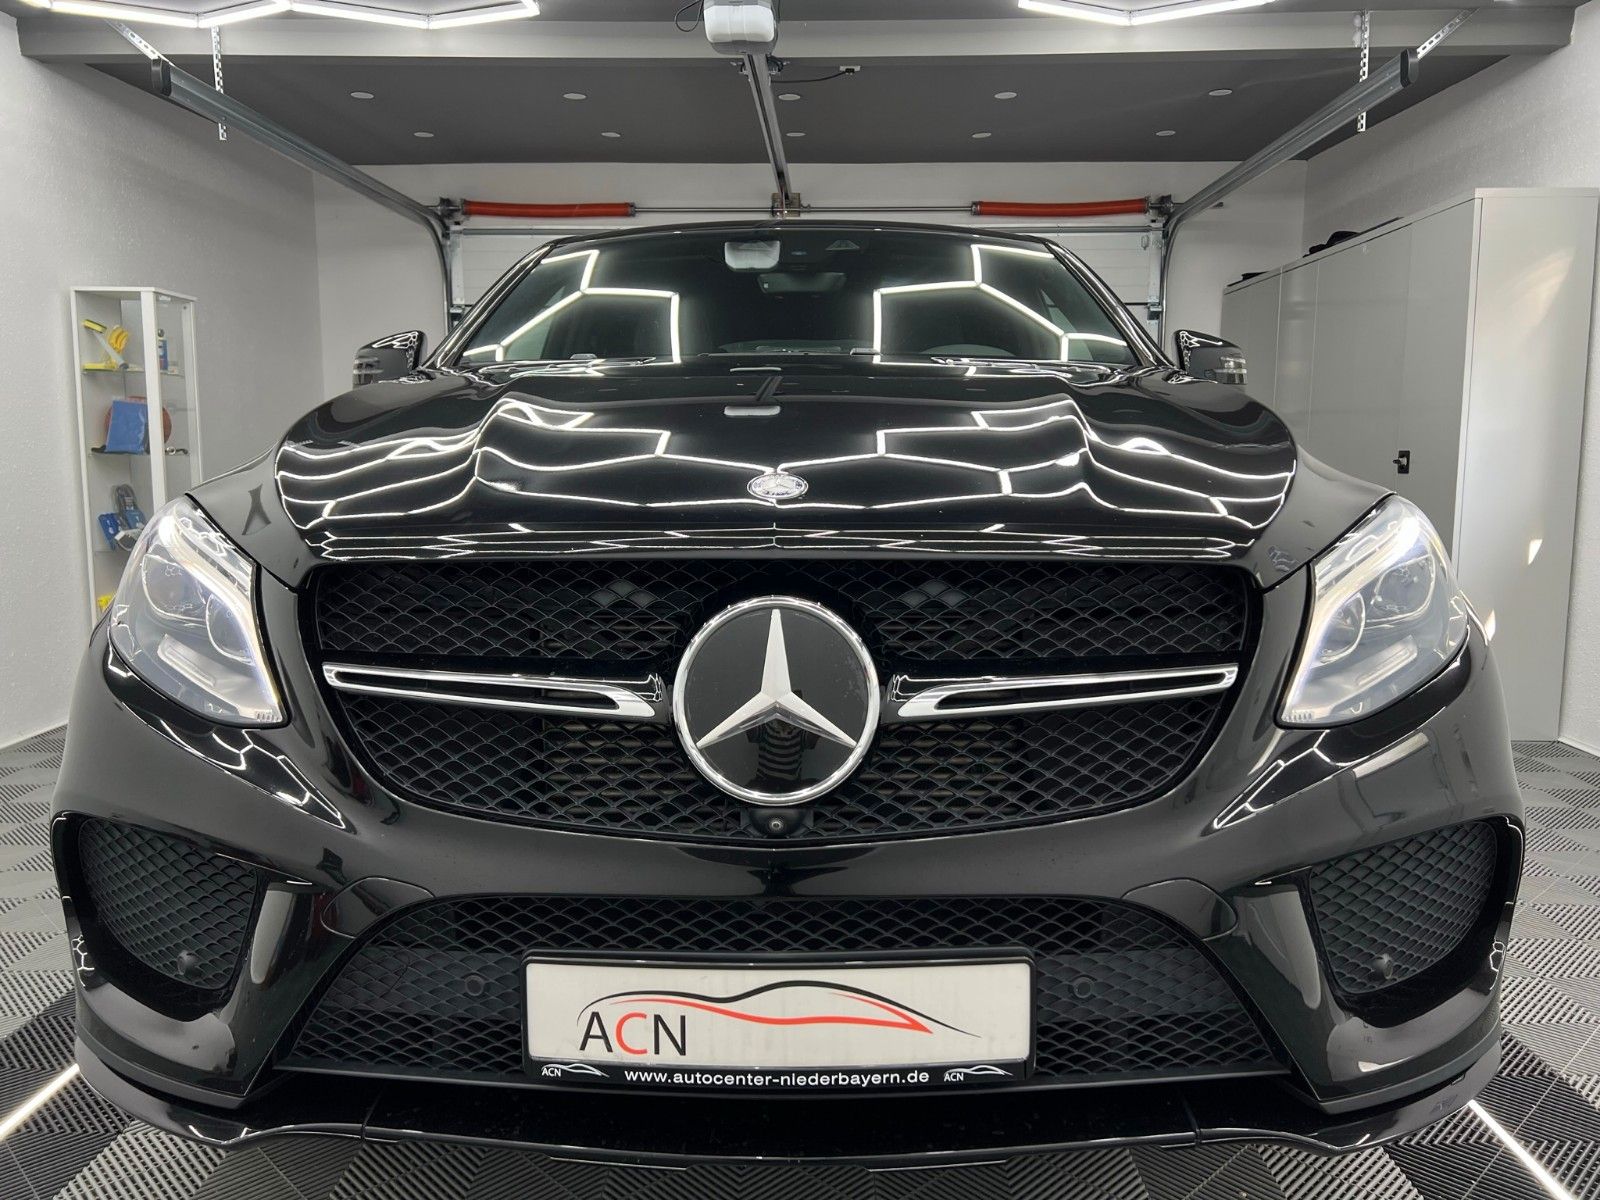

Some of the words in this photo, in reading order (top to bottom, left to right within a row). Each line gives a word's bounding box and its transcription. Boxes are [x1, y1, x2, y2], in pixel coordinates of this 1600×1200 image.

[579, 1011, 687, 1056] ACN
[541, 1067, 562, 1078] ACN
[624, 1069, 930, 1087] www.autocenter-niederbayern.de
[943, 1072, 965, 1083] ACN
